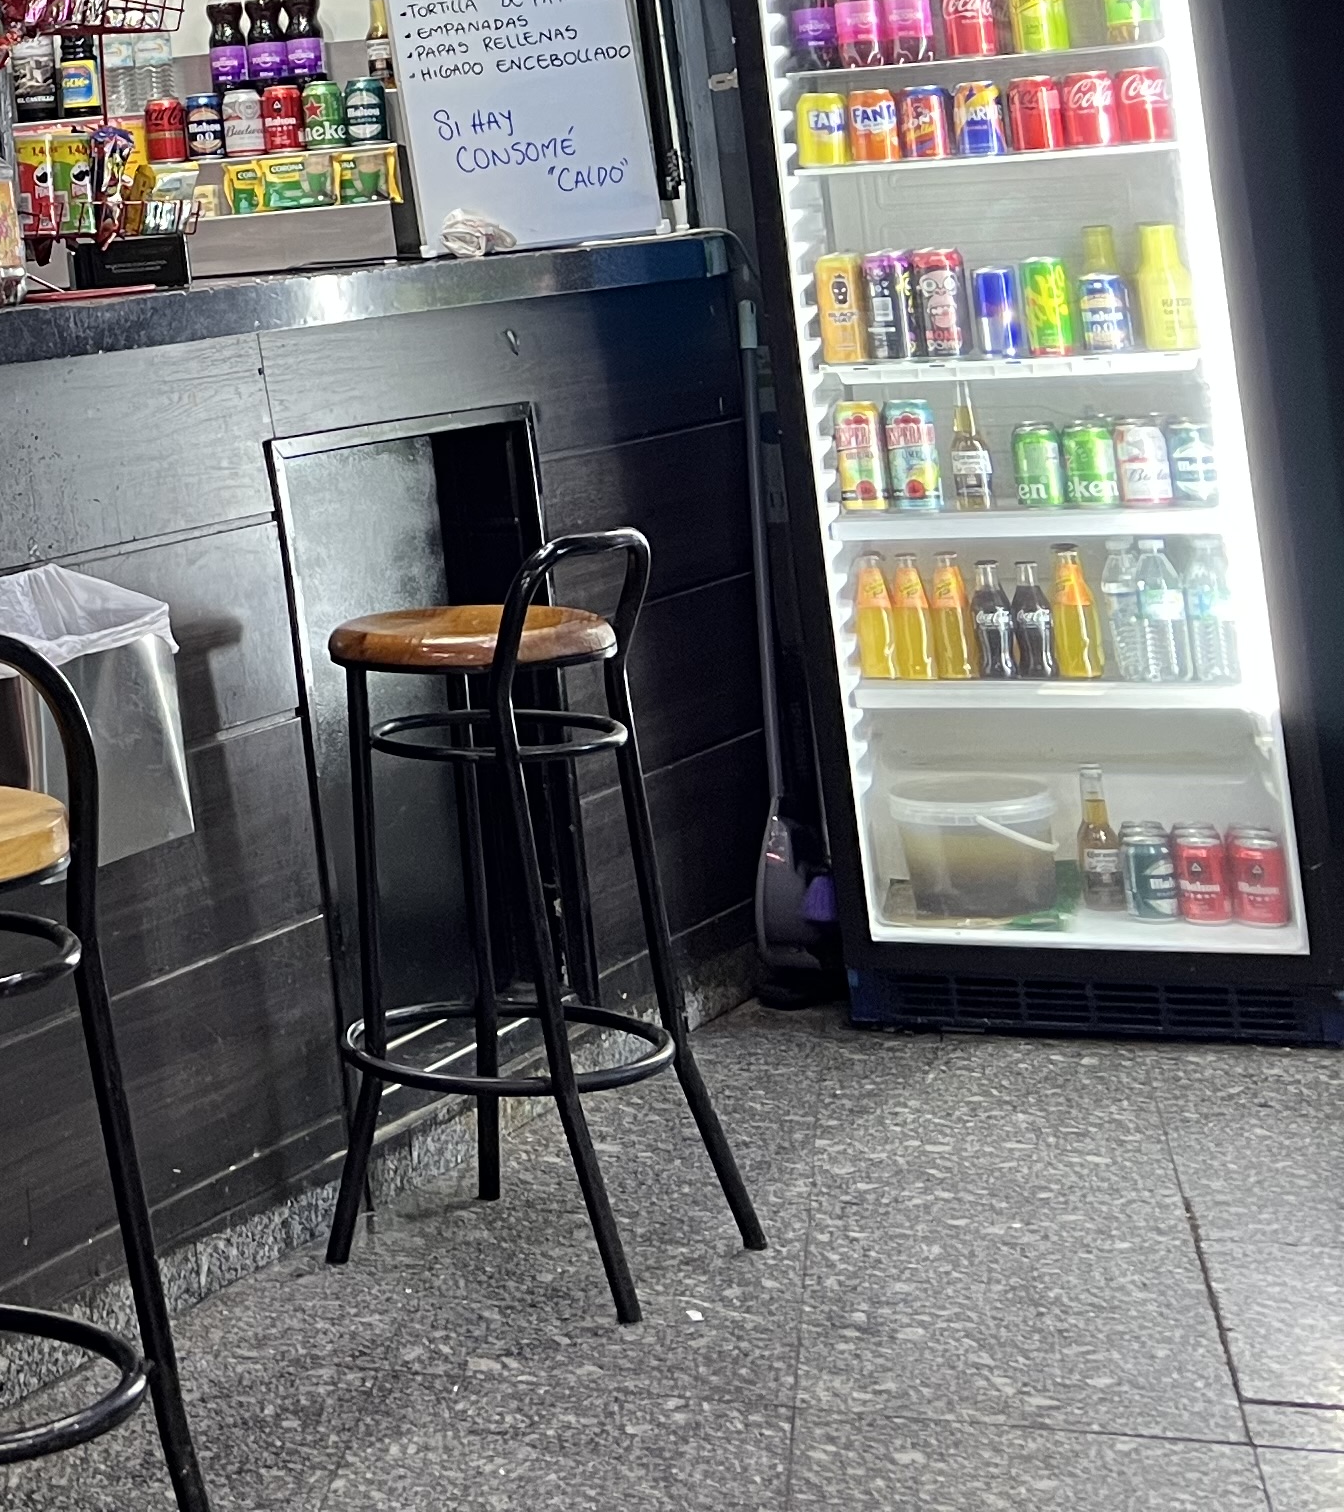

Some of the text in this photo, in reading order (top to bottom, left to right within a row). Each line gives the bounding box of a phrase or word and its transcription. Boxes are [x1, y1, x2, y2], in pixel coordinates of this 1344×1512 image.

[408, 0, 478, 19] TORTILLA
[417, 15, 529, 40] EMPANADAS
[415, 25, 578, 62] PAPAS RELLENAS
[421, 45, 632, 82] HIGADO ENCEBOLLADO
[188, 122, 221, 134] Mahou
[471, 109, 514, 137] HAY
[456, 126, 577, 173] CONSOMÉ
